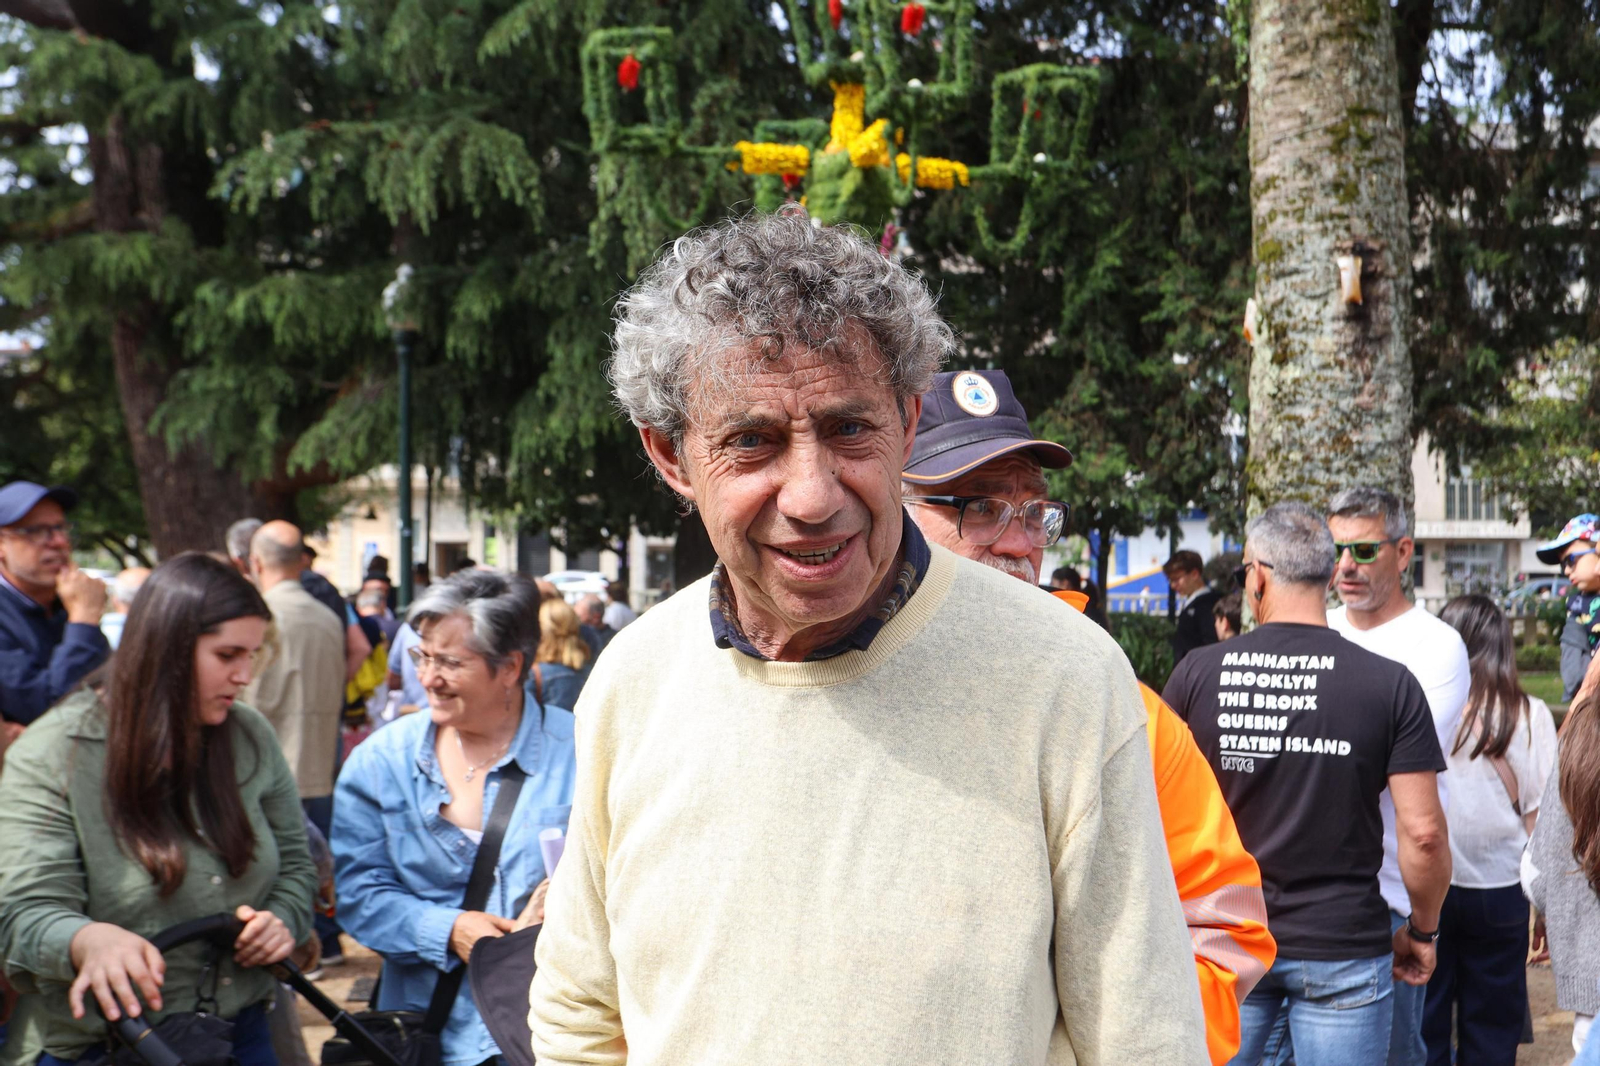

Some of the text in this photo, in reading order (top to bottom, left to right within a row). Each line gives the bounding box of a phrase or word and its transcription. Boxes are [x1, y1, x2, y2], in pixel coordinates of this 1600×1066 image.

[1222, 652, 1335, 670] MANHATTAN
[1219, 671, 1317, 690] BROOKLYN
[1218, 692, 1318, 711] THE BRONX
[1217, 713, 1288, 731] QUEENS
[1219, 735, 1352, 756] STATEN ISLAND
[1221, 756, 1255, 773] NYC
